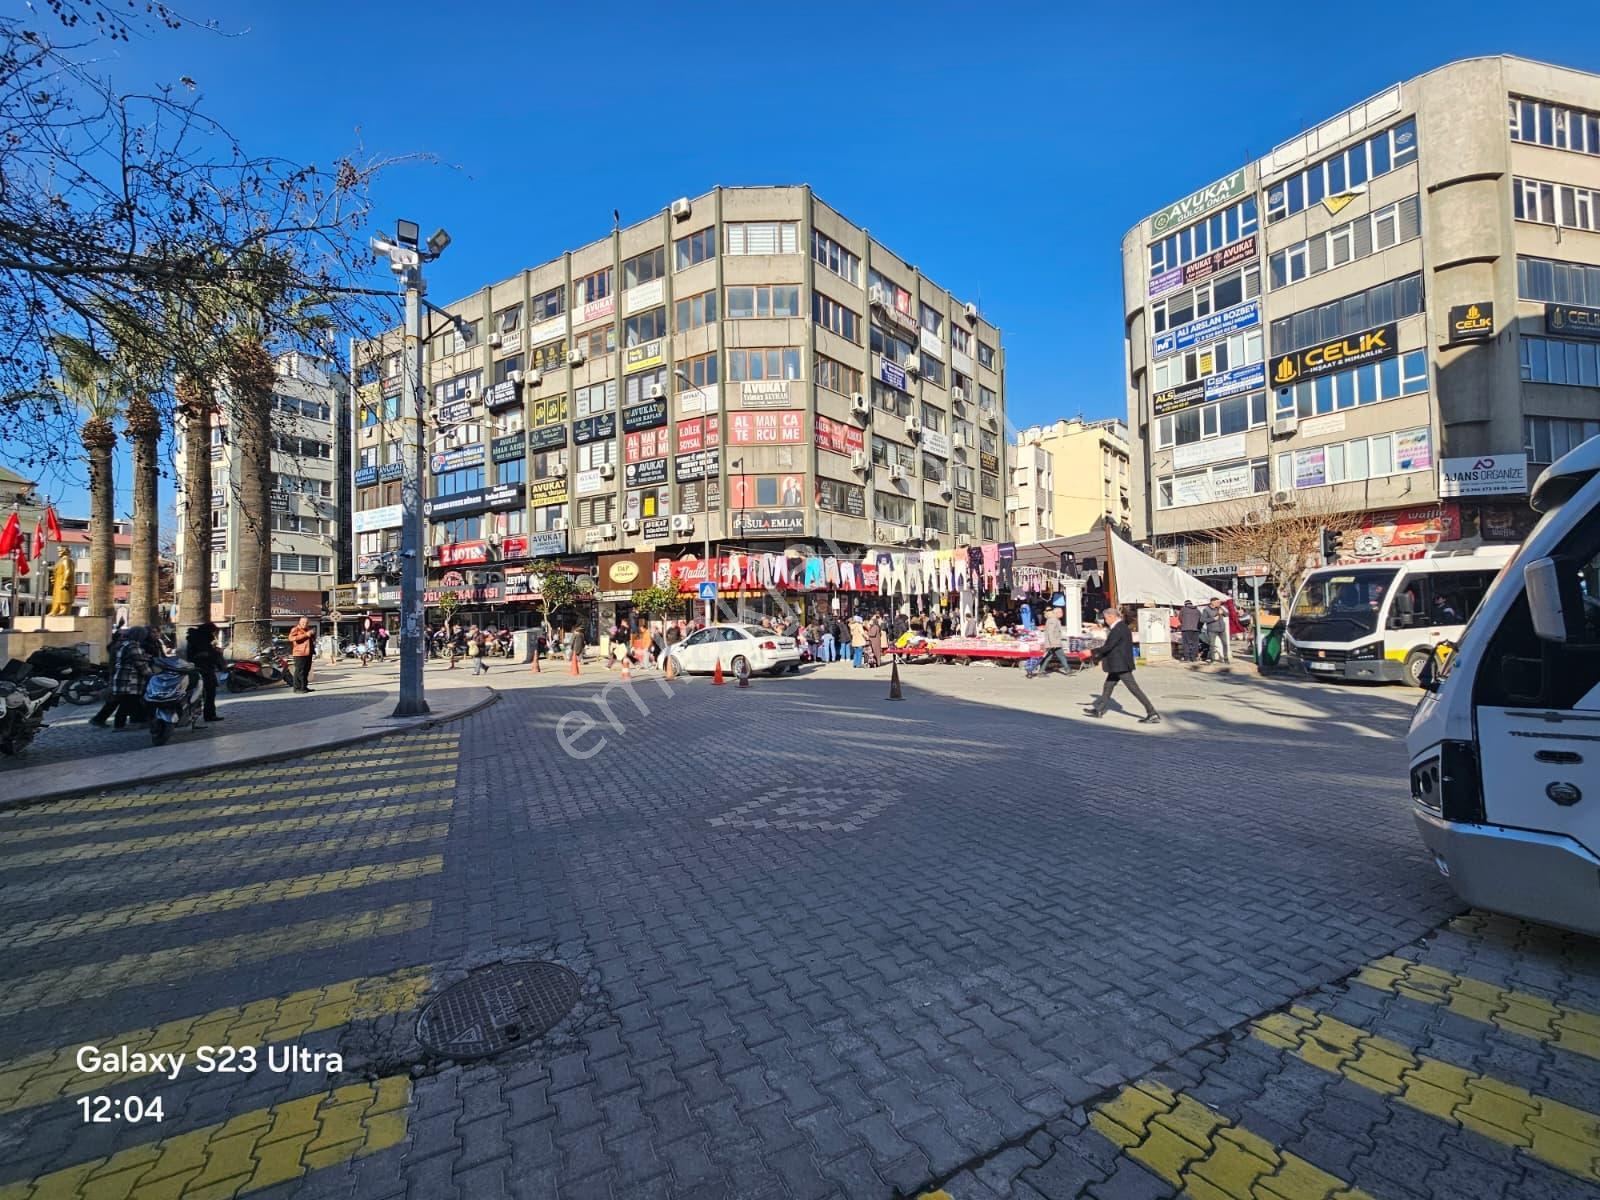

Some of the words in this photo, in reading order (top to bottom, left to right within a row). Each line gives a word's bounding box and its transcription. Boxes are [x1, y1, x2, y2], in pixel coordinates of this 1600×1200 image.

[1169, 173, 1240, 220] AVUKAT
[1223, 239, 1253, 258] AVUKAT
[1187, 257, 1213, 273] AVUKAT
[585, 298, 614, 313] AVUKAT
[1190, 318, 1221, 334] ARSLAN
[744, 383, 787, 394] AVUKAT
[1155, 391, 1174, 404] ALS
[630, 403, 657, 417] AVUKAT
[735, 416, 746, 427] AL
[756, 415, 776, 427] MAN
[783, 414, 799, 426] CA
[627, 435, 639, 446] AL
[736, 430, 748, 441] TE
[756, 430, 776, 441] RCU
[782, 428, 801, 440] ME
[628, 448, 638, 459] TE
[638, 460, 665, 473] AVUKAT
[1444, 471, 1479, 482] AJANS
[532, 480, 566, 493] AVUKAT
[772, 518, 802, 528] EMLAK
[532, 532, 562, 543] AVUKAT
